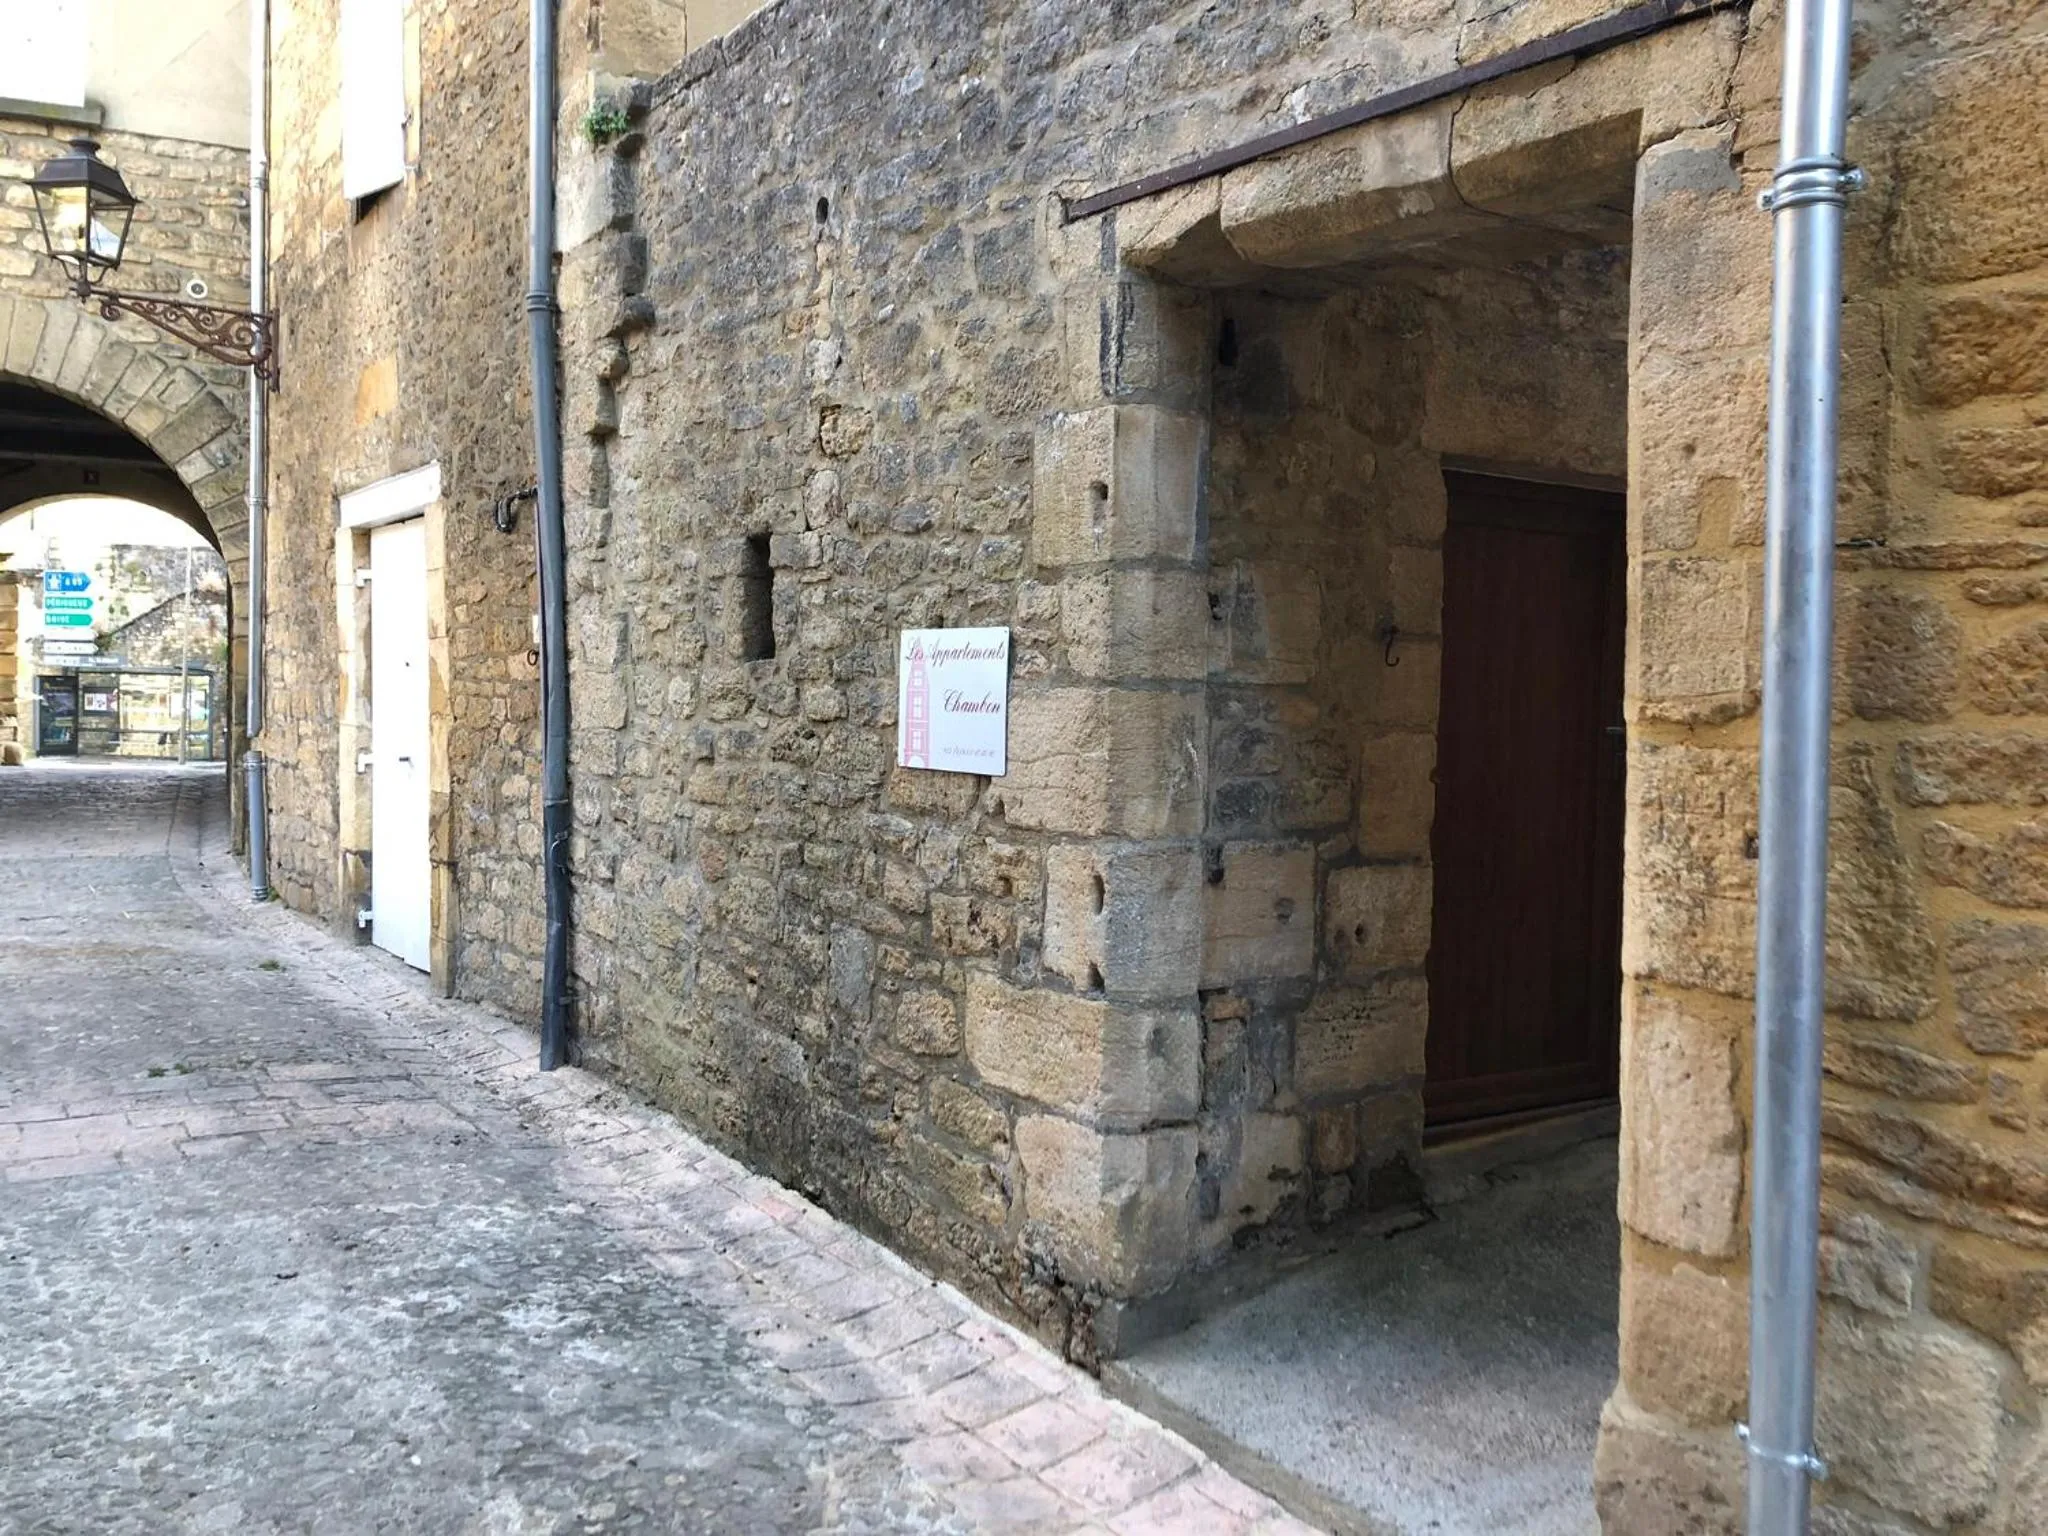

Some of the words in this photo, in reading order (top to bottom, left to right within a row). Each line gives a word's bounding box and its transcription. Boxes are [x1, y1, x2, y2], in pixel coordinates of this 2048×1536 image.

[906, 636, 924, 661] Les
[926, 637, 1005, 668] Appartements
[944, 689, 1000, 714] Chambon
